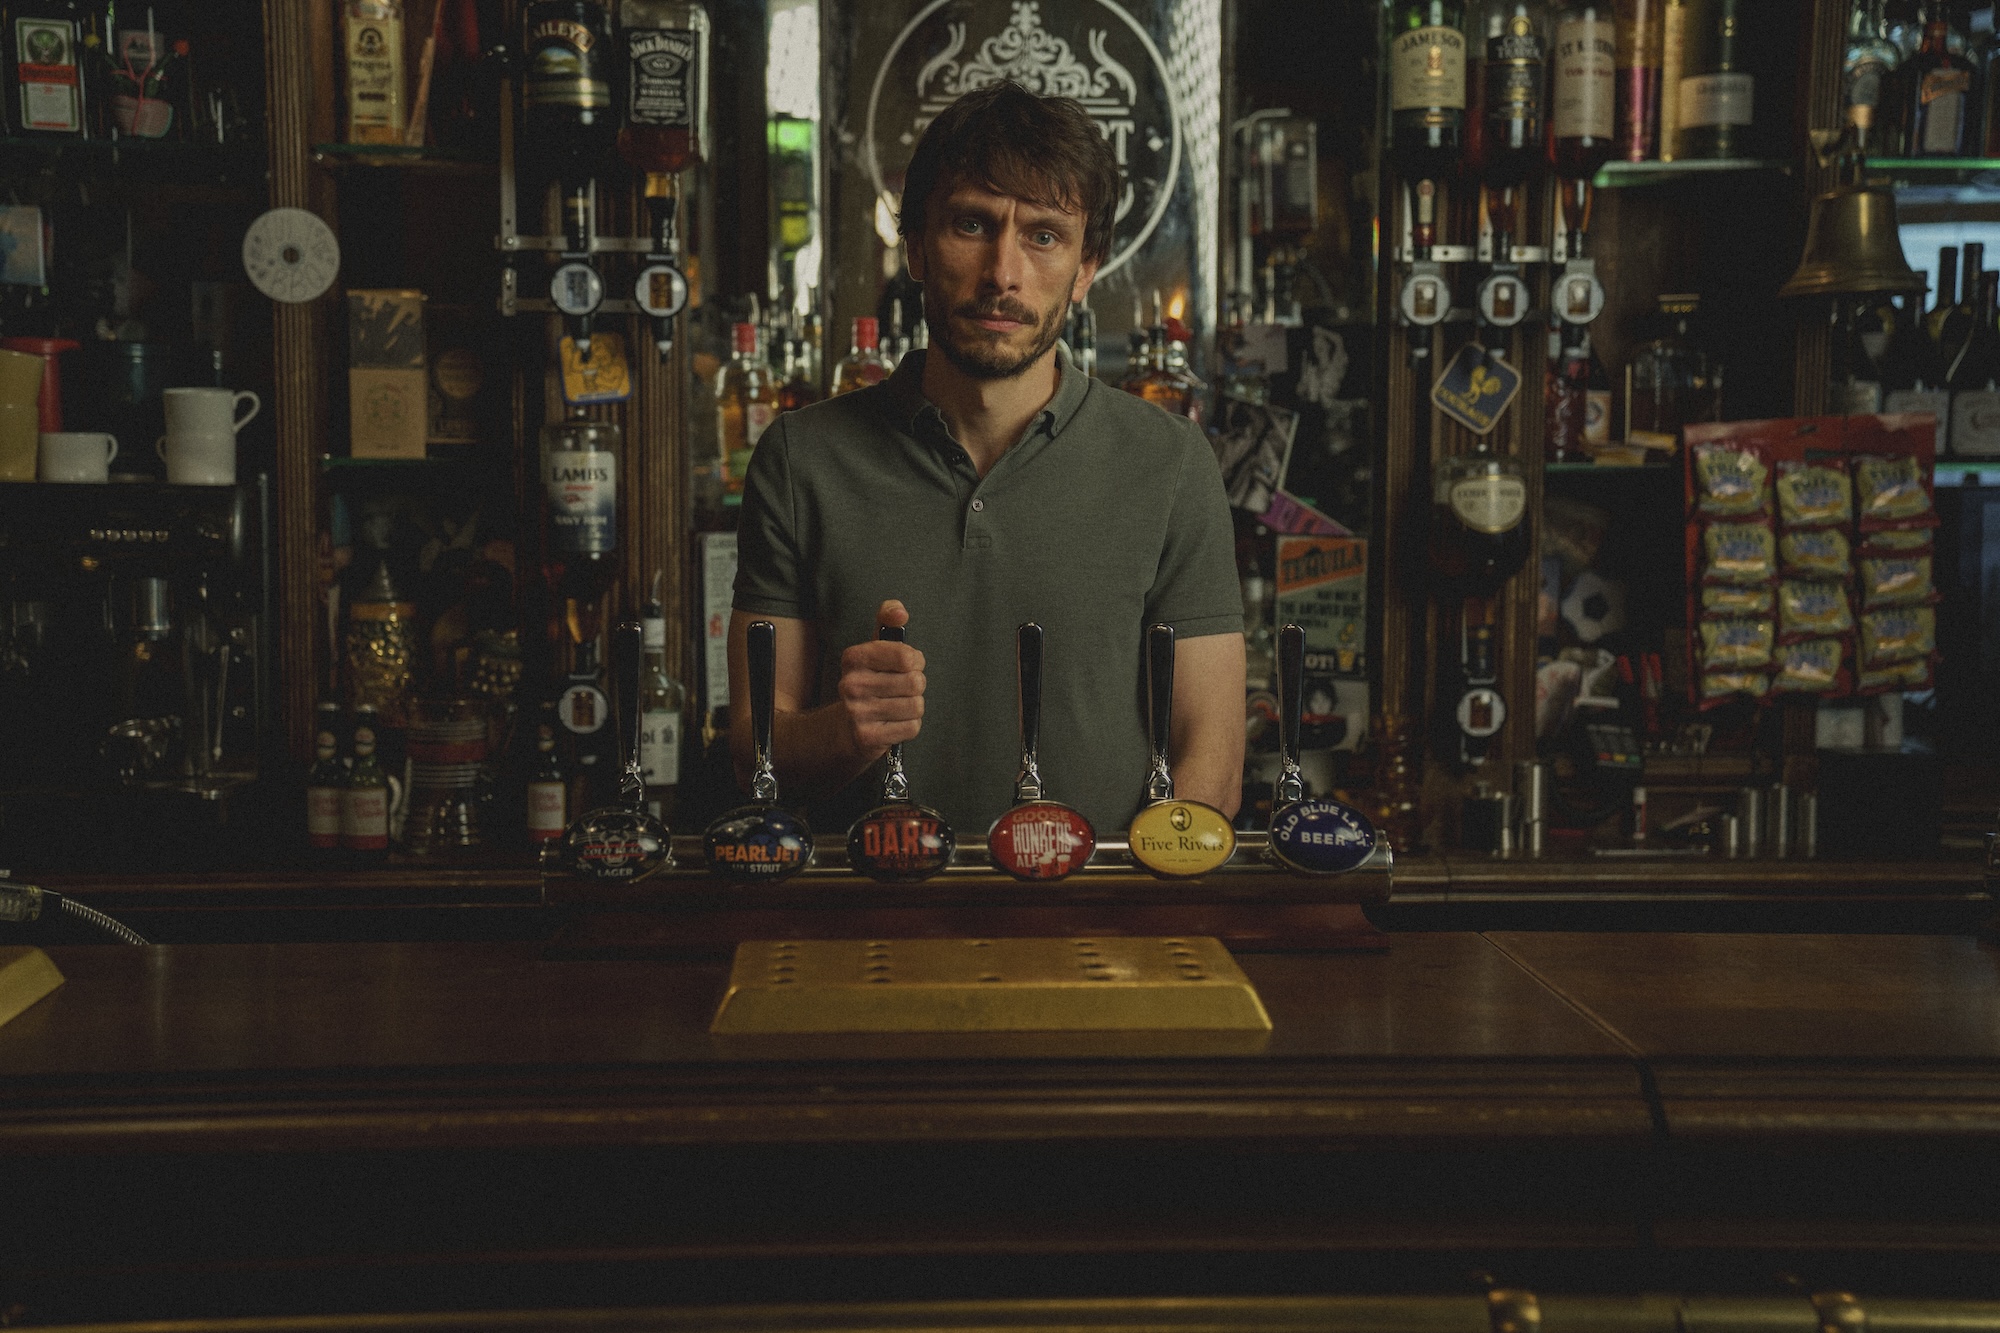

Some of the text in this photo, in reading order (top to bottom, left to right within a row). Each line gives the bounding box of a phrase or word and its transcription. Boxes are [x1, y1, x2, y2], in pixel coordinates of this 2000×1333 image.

[628, 40, 655, 60] JACK
[1281, 544, 1362, 584] TEQUILA
[1304, 653, 1336, 671] OT!
[1012, 810, 1069, 823] GOOSE
[1279, 803, 1368, 847] OLD BLUE LAST
[863, 819, 940, 858] DARK
[1011, 822, 1073, 855] HONKERS
[1141, 836, 1225, 852] Five Rivers
[1301, 831, 1346, 847] BEER
[714, 844, 801, 862] PEARL JET
[597, 867, 634, 878] LAGER
[749, 863, 781, 874] STOUT
